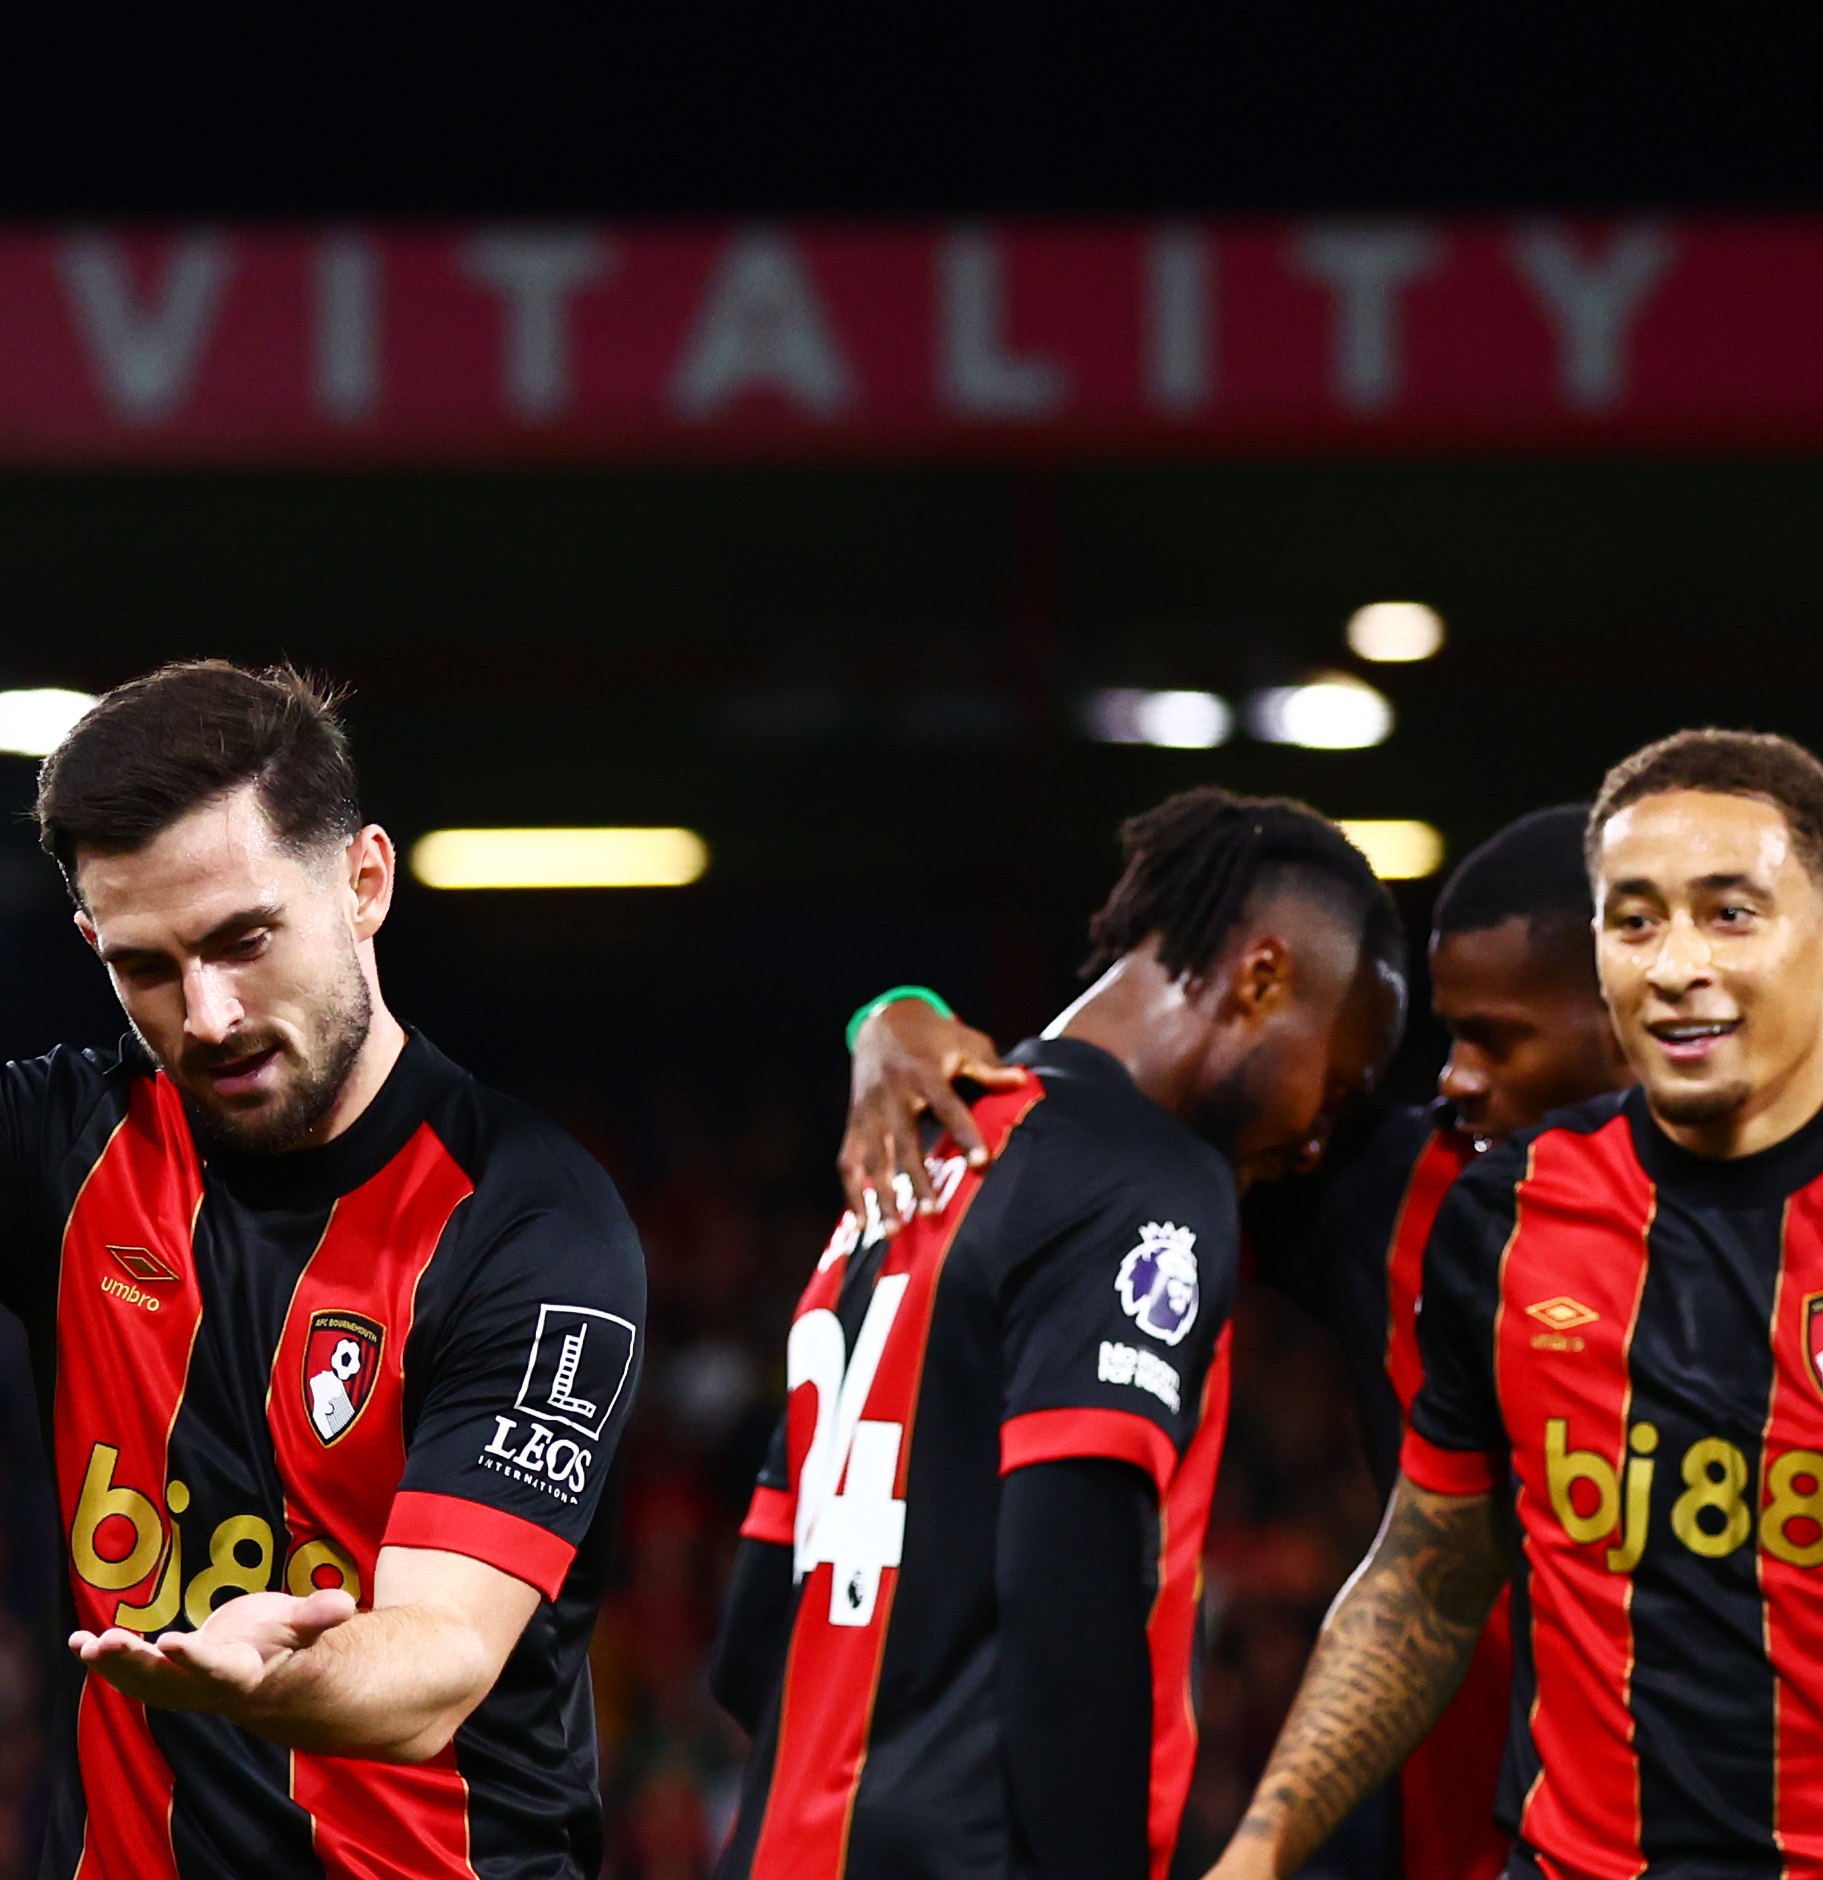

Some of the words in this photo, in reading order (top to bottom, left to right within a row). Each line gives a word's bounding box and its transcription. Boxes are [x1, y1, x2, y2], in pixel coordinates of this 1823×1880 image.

[60, 232, 1668, 422] VITALITY
[100, 1275, 161, 1312] umbro
[328, 1318, 378, 1343] BOURNEMOUTH
[484, 1415, 593, 1493] LEOS
[786, 1273, 907, 1627] 24
